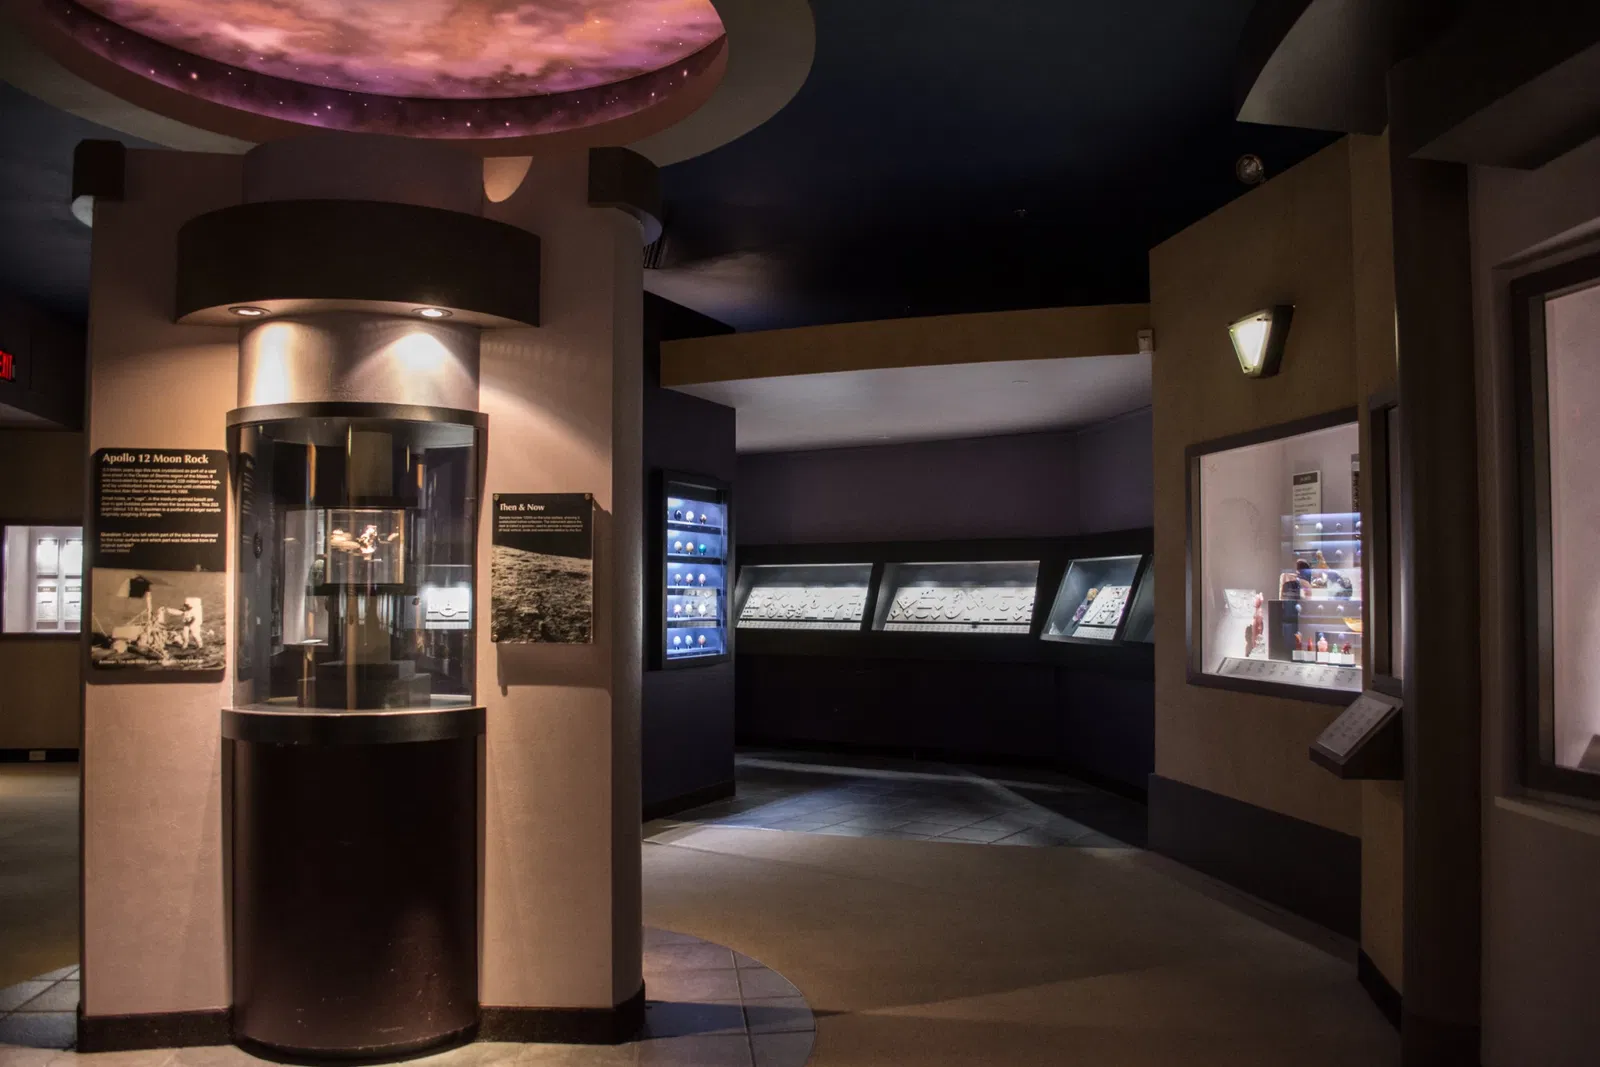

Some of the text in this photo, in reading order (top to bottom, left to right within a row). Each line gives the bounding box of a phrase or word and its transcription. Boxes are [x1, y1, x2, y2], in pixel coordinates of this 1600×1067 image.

[102, 453, 209, 464] Apollo 12 Moon Rock
[500, 503, 517, 511] Then
